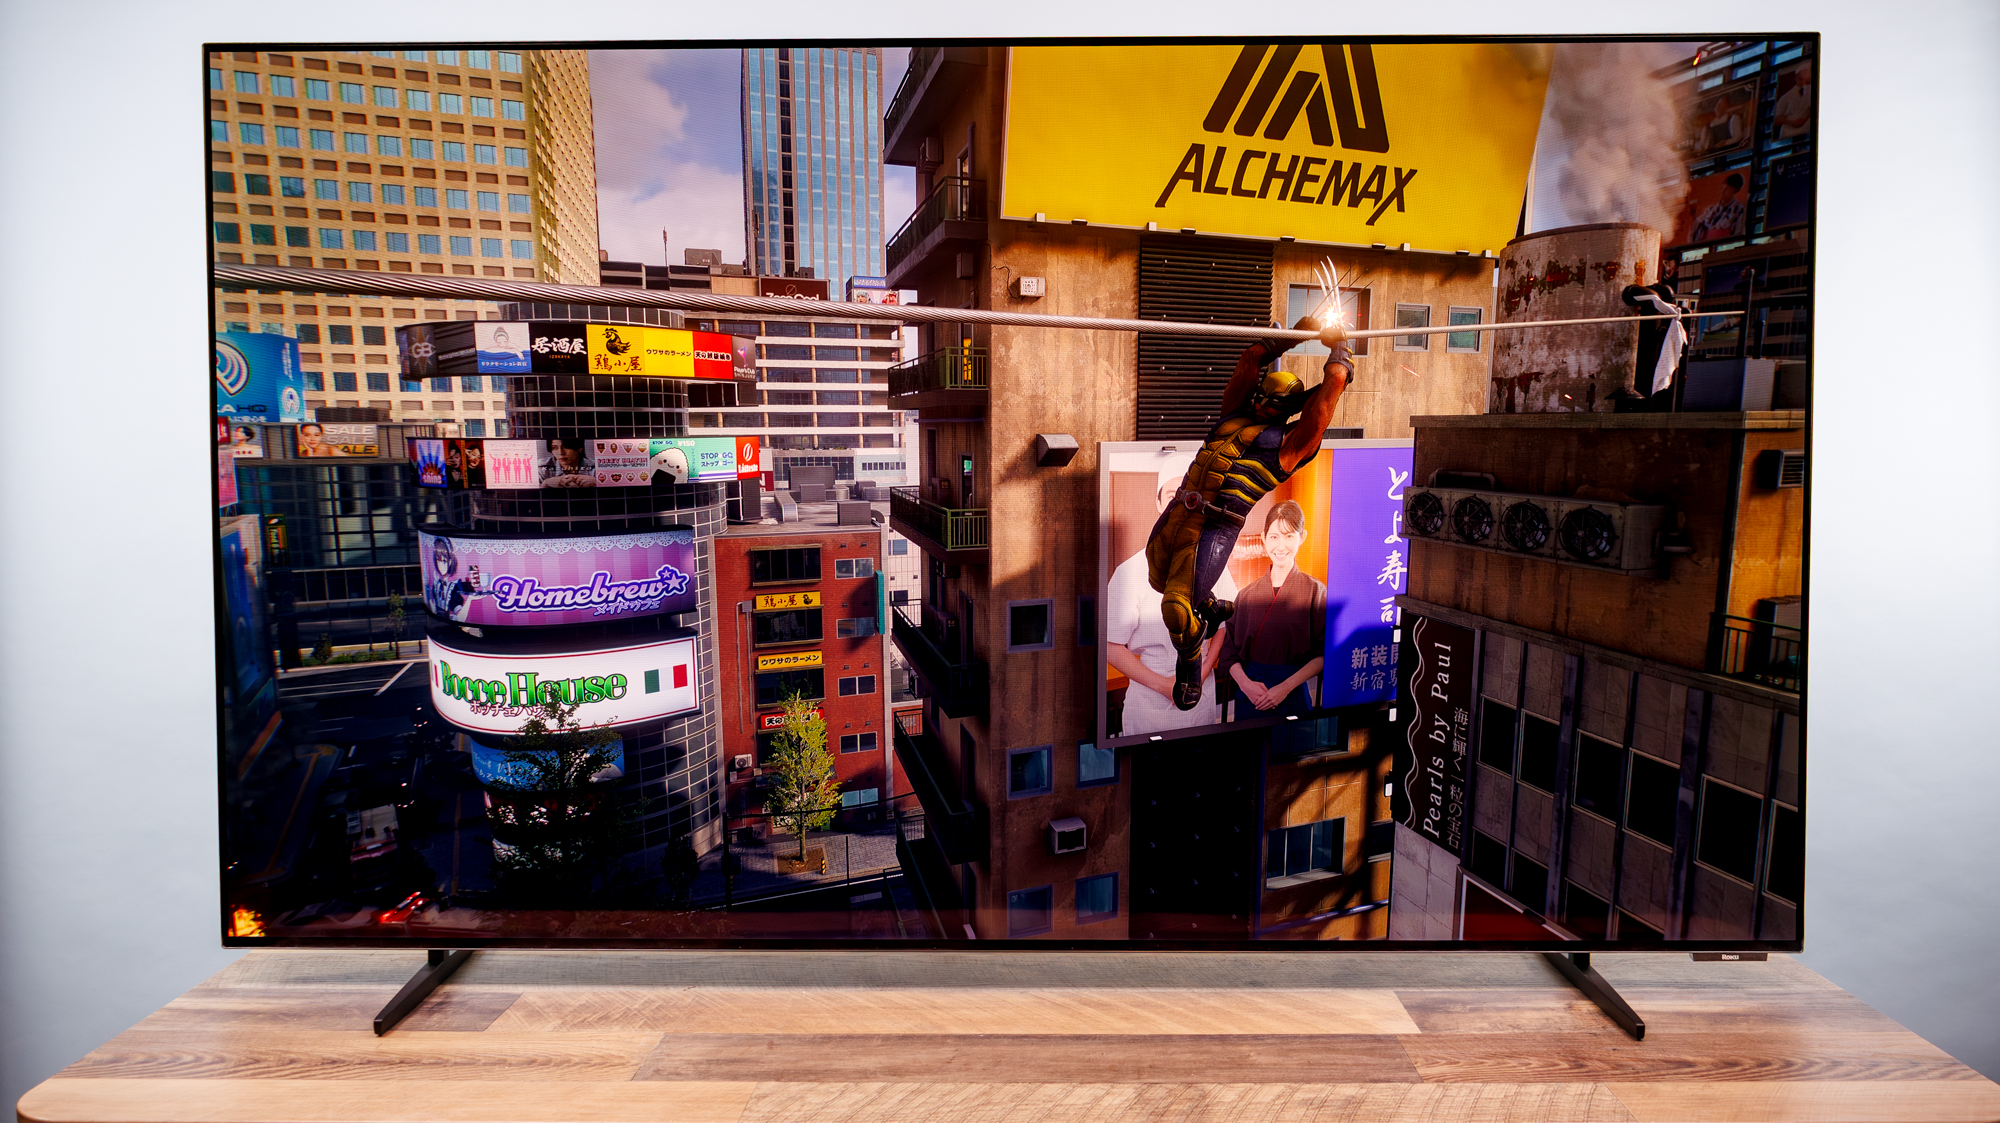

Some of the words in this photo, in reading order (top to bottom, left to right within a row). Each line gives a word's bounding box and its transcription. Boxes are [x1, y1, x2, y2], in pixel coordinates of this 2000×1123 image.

[1154, 143, 1418, 226] ALCHEMAX
[531, 336, 587, 355] 居酒屋
[646, 348, 692, 357] ウワサのラーメン
[217, 403, 268, 413] AHQ
[324, 425, 376, 435] SALE
[326, 435, 377, 445] SALE
[340, 445, 376, 455] ALE
[700, 452, 718, 460] STOP
[493, 571, 665, 611] Homebrew
[593, 598, 661, 616] メイドカフェ
[760, 654, 820, 666] ウワサのラーメン
[1431, 642, 1451, 702] Paul
[440, 660, 507, 706] Bocce
[506, 672, 627, 708] House
[1429, 714, 1450, 744] by
[1446, 706, 1469, 850] 海に輝く一粒の宝石
[1423, 756, 1445, 839] Pearls
